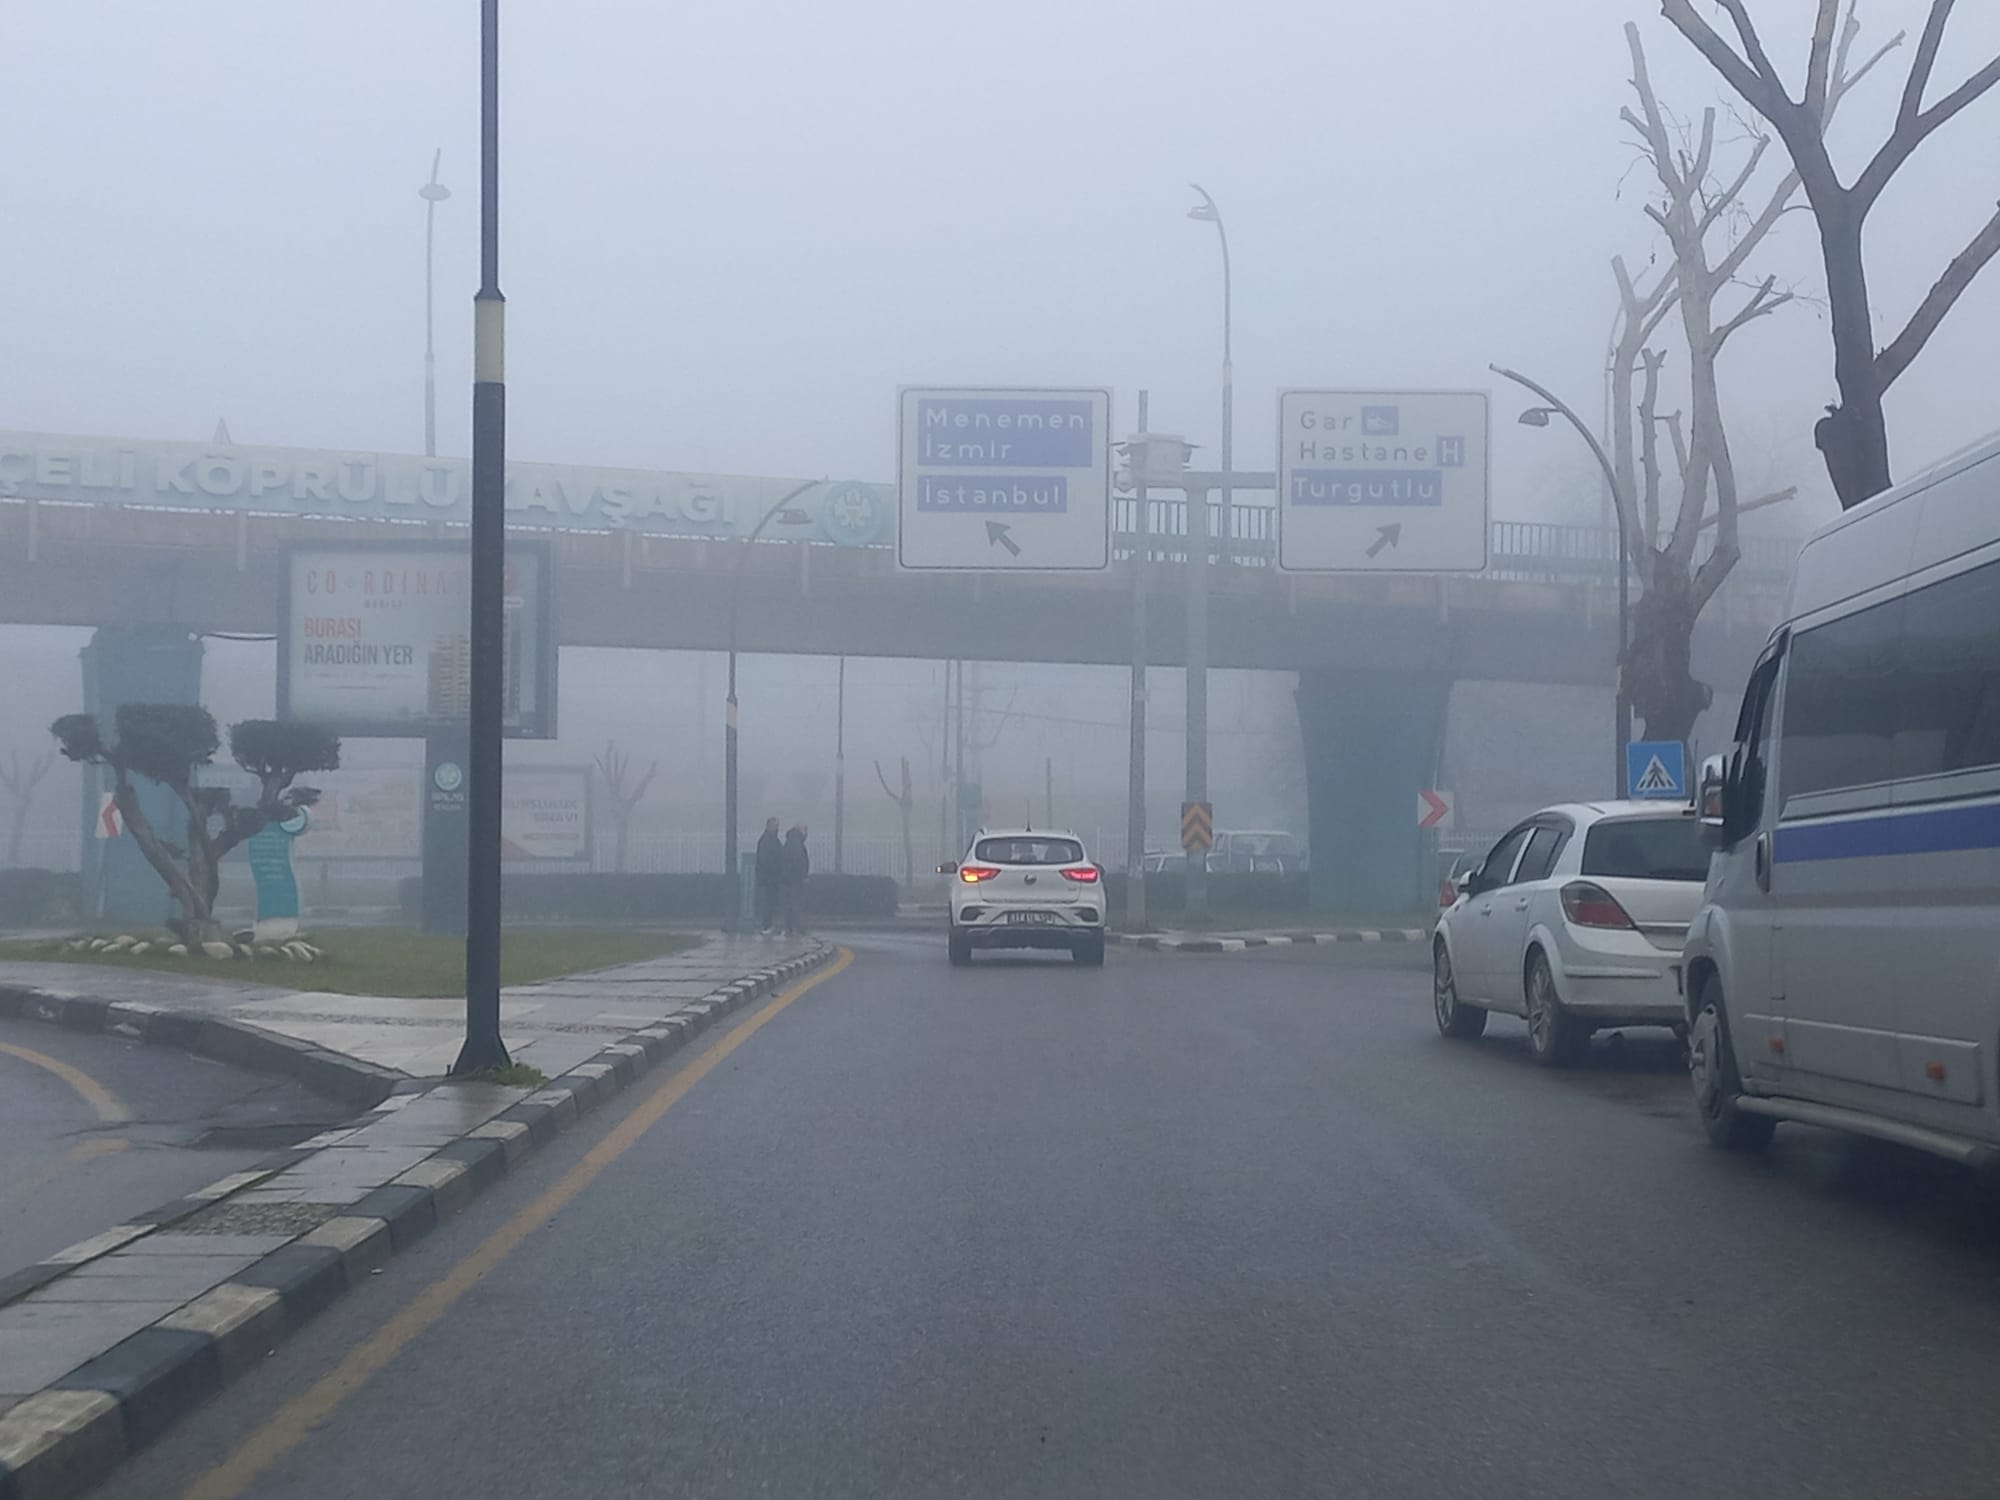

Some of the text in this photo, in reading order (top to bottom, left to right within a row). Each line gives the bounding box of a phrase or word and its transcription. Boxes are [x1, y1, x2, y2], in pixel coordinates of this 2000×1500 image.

[926, 407, 1085, 429] Menemen
[1300, 410, 1353, 430] Gar
[926, 434, 1013, 459] İzmir
[1300, 439, 1459, 463] Hastane H
[156, 446, 464, 507] KÖPRÜLÜ
[503, 478, 737, 529] AVŞAĞI
[926, 480, 1059, 505] İstanbul
[1294, 477, 1433, 503] Turgutlu
[304, 616, 361, 639] BURASI
[382, 645, 413, 665] YER
